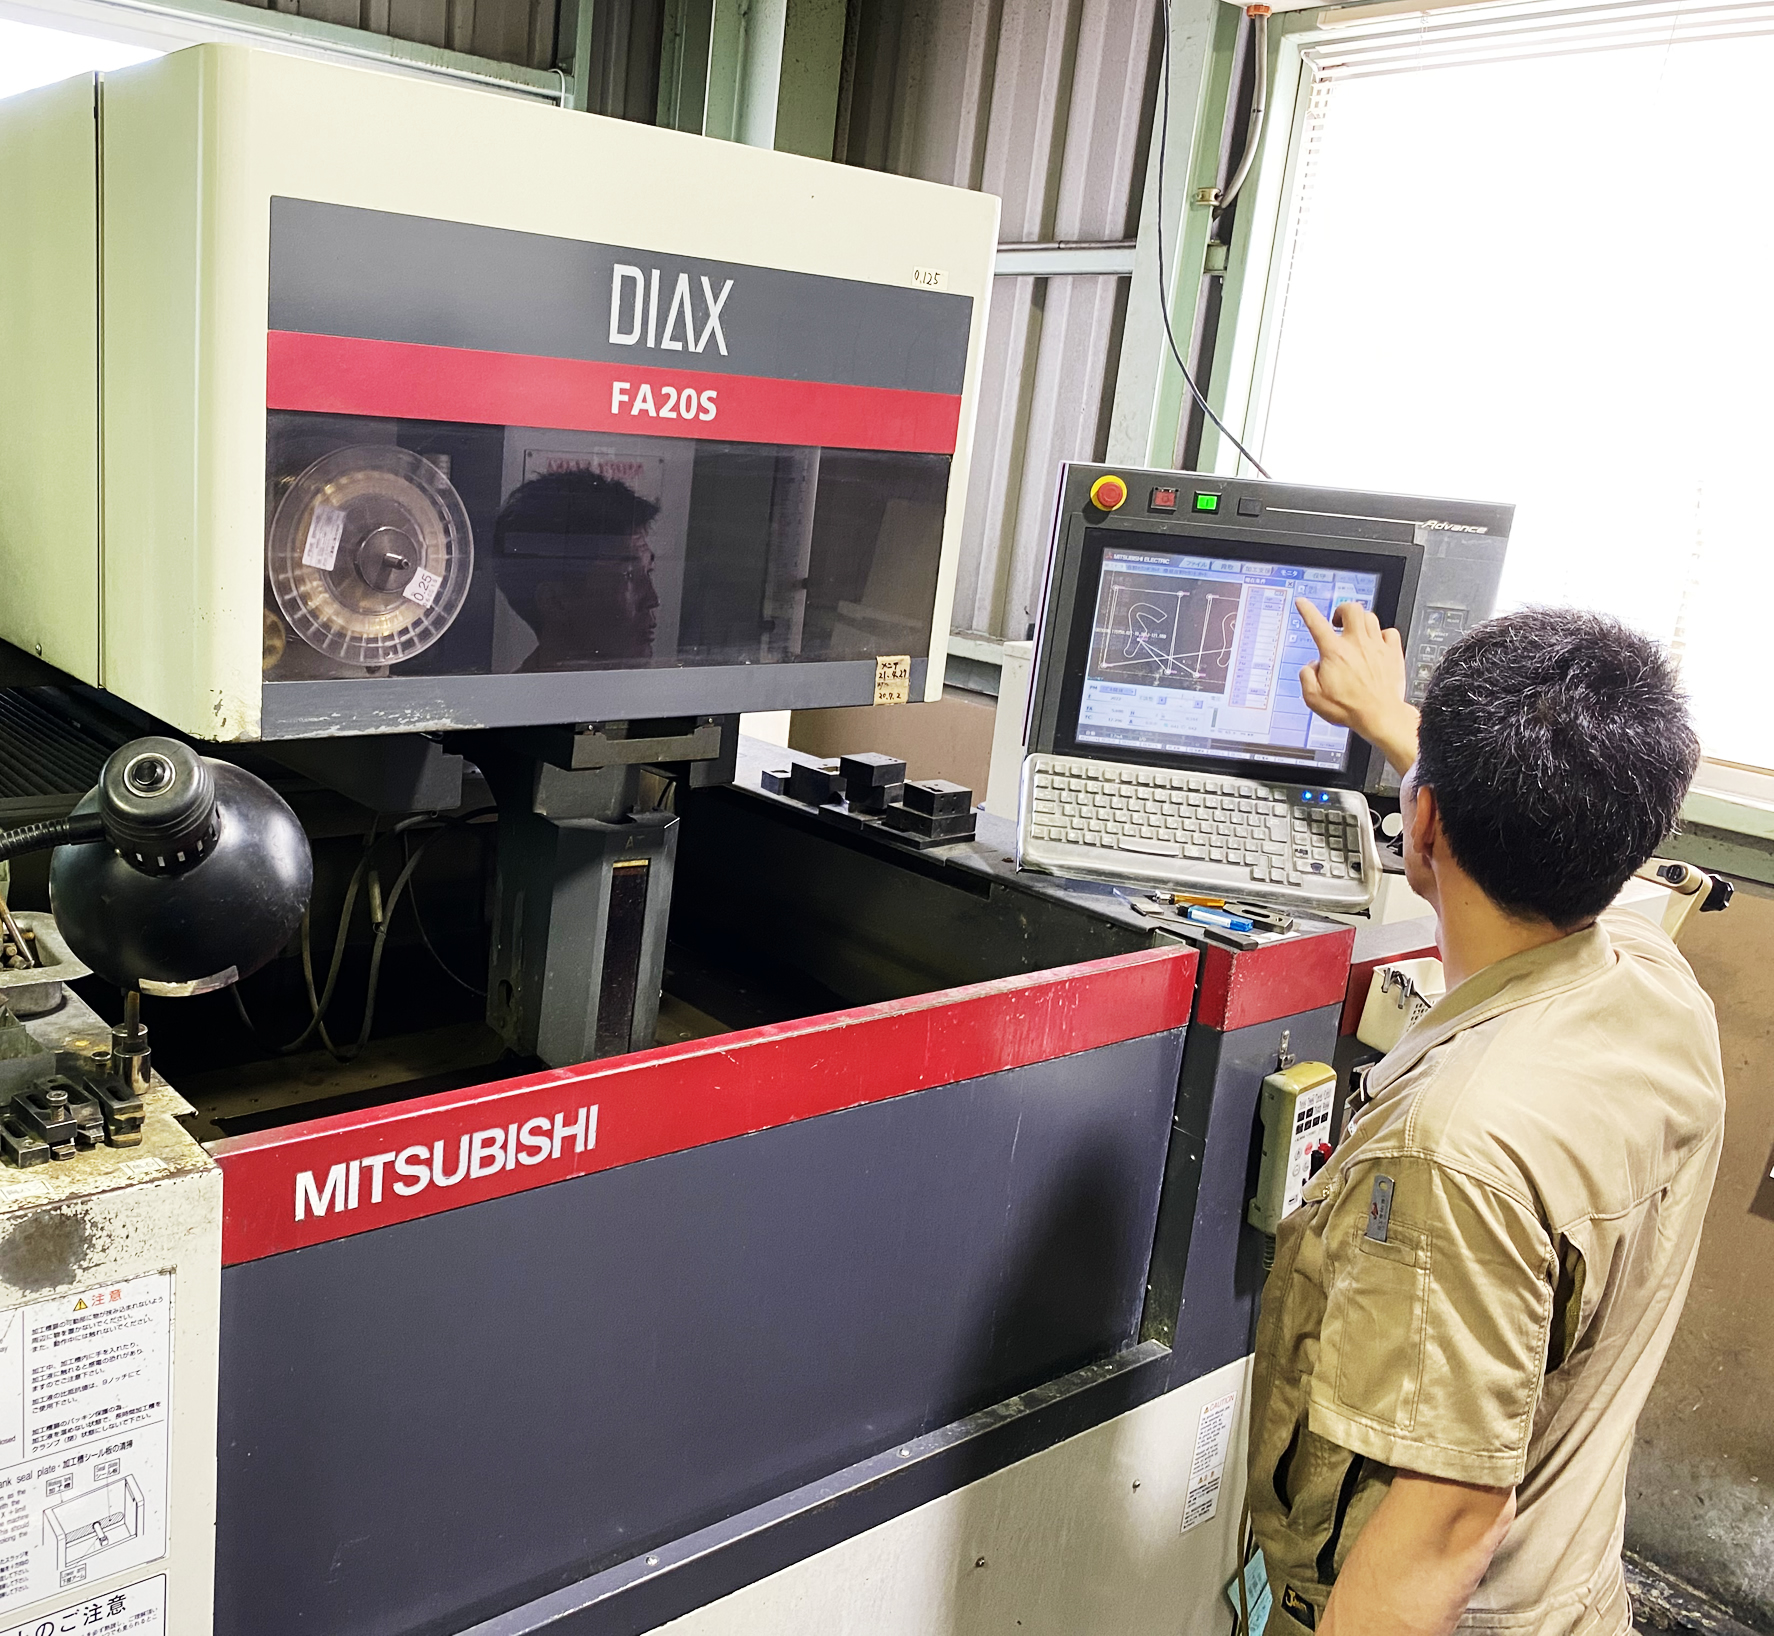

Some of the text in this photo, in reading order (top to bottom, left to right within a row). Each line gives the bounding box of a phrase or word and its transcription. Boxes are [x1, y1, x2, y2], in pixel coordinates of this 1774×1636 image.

[914, 269, 941, 286] 0.125
[608, 263, 734, 356] DIAX
[611, 381, 717, 421] FA20S
[1422, 519, 1488, 534] Advance
[1113, 553, 1170, 565] MITSUBISHI ELECTRIC
[413, 573, 432, 602] 0.25
[294, 1104, 600, 1221] MITSUBISHI
[91, 1289, 122, 1307] 注意
[1209, 1394, 1235, 1412] CAUTION
[16, 1470, 33, 1483] seal
[37, 1464, 56, 1479] plate
[18, 1593, 127, 1636] のご注意
